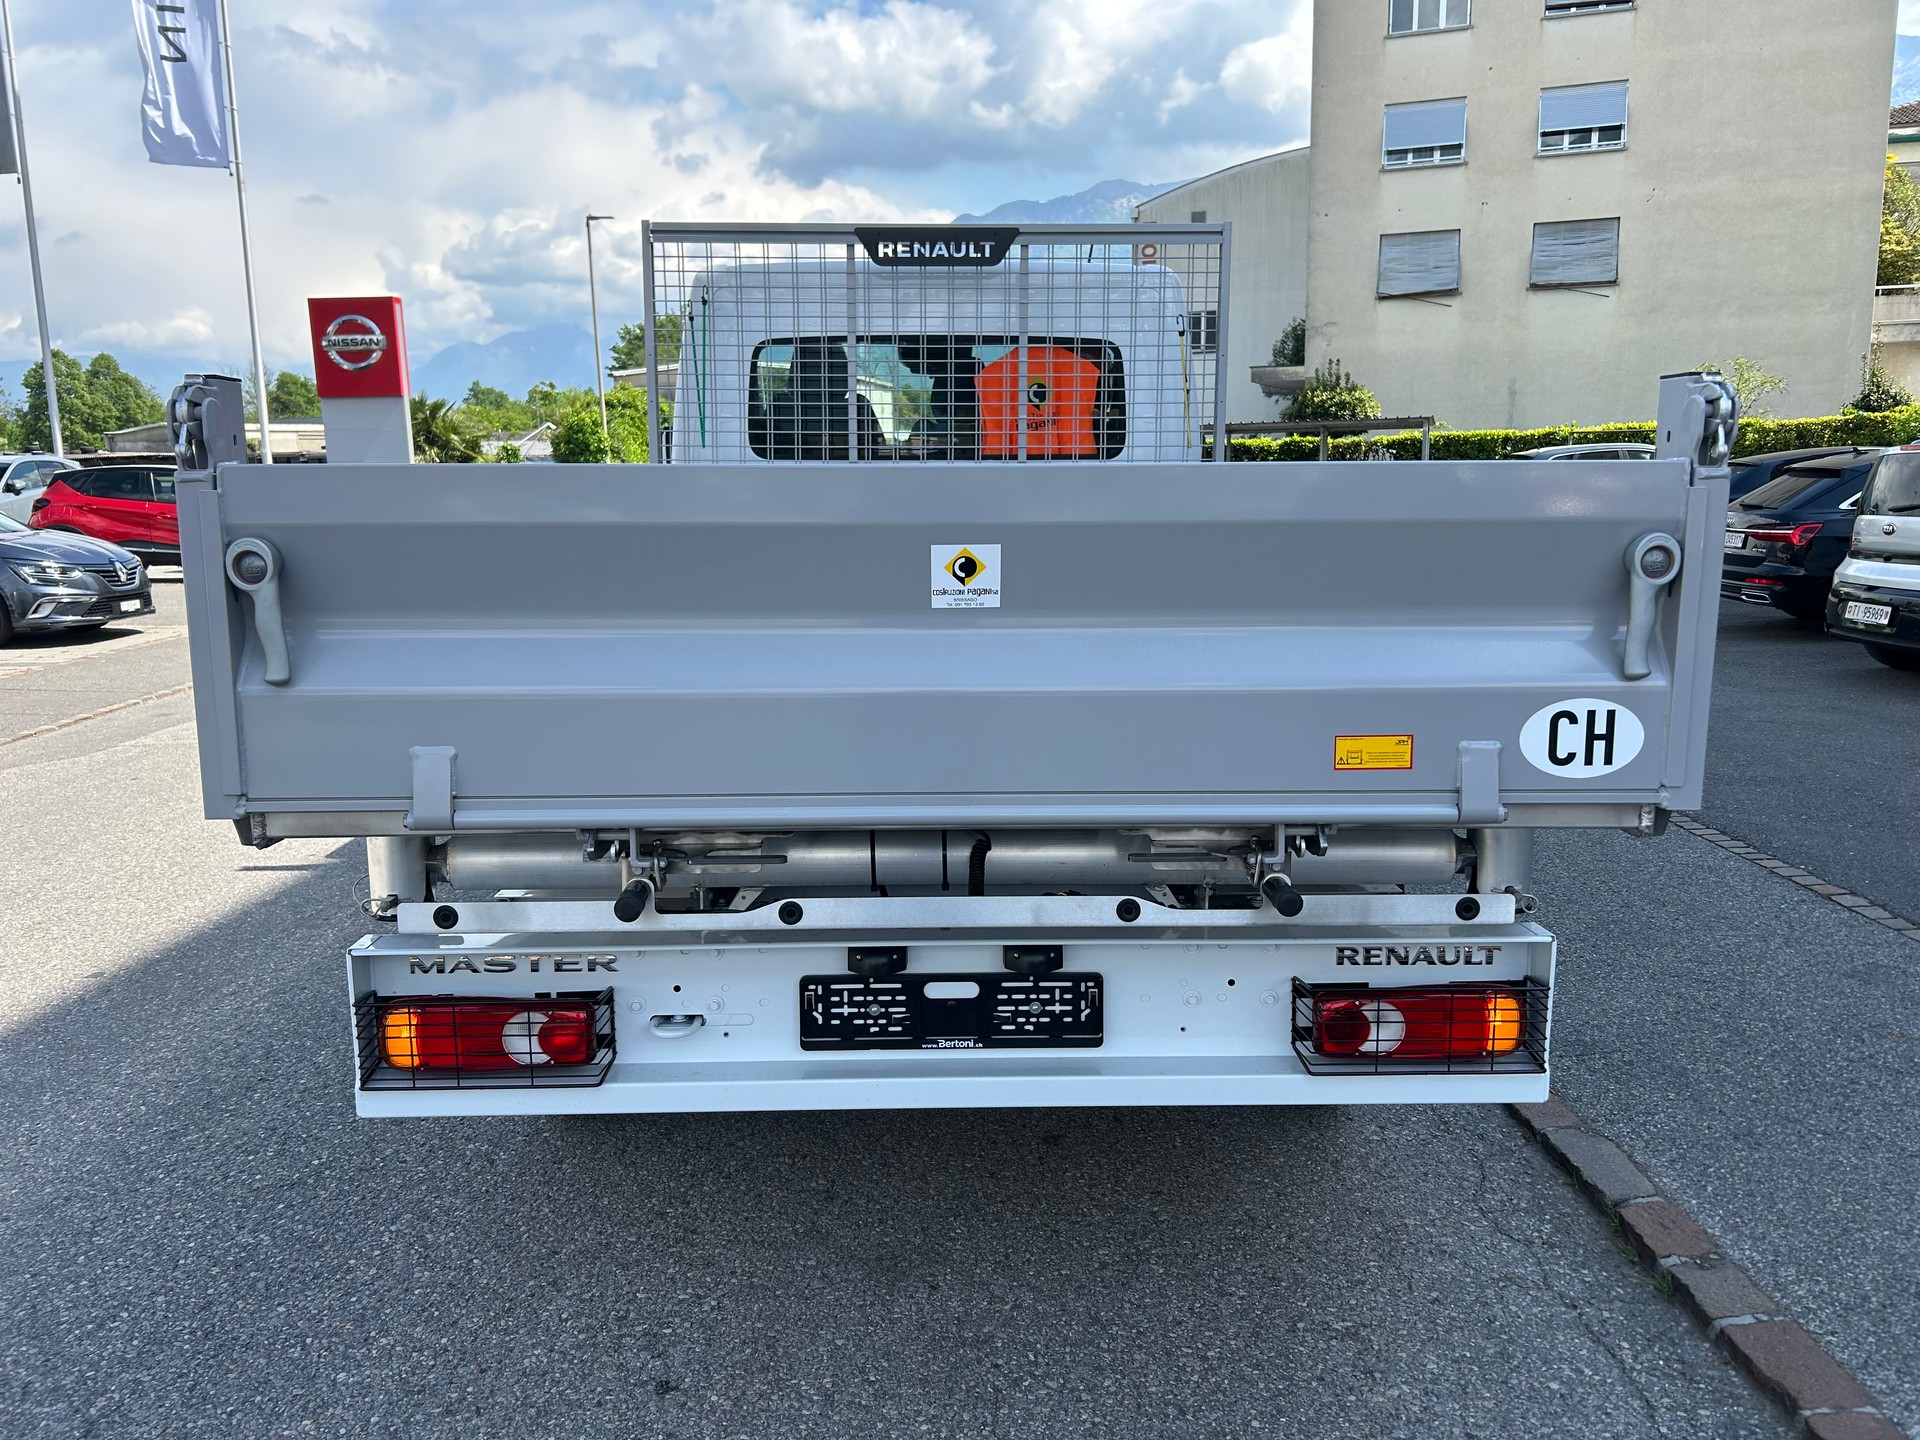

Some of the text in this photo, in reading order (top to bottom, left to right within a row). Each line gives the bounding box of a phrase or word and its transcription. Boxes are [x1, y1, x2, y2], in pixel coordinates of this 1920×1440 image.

[878, 241, 996, 259] RENAULT
[327, 338, 379, 347] NISSAN
[1548, 709, 1616, 767] CH
[409, 953, 619, 975] MASTER
[1335, 945, 1502, 967] RENAULT
[921, 1039, 984, 1049] www.Bertoni.ch
